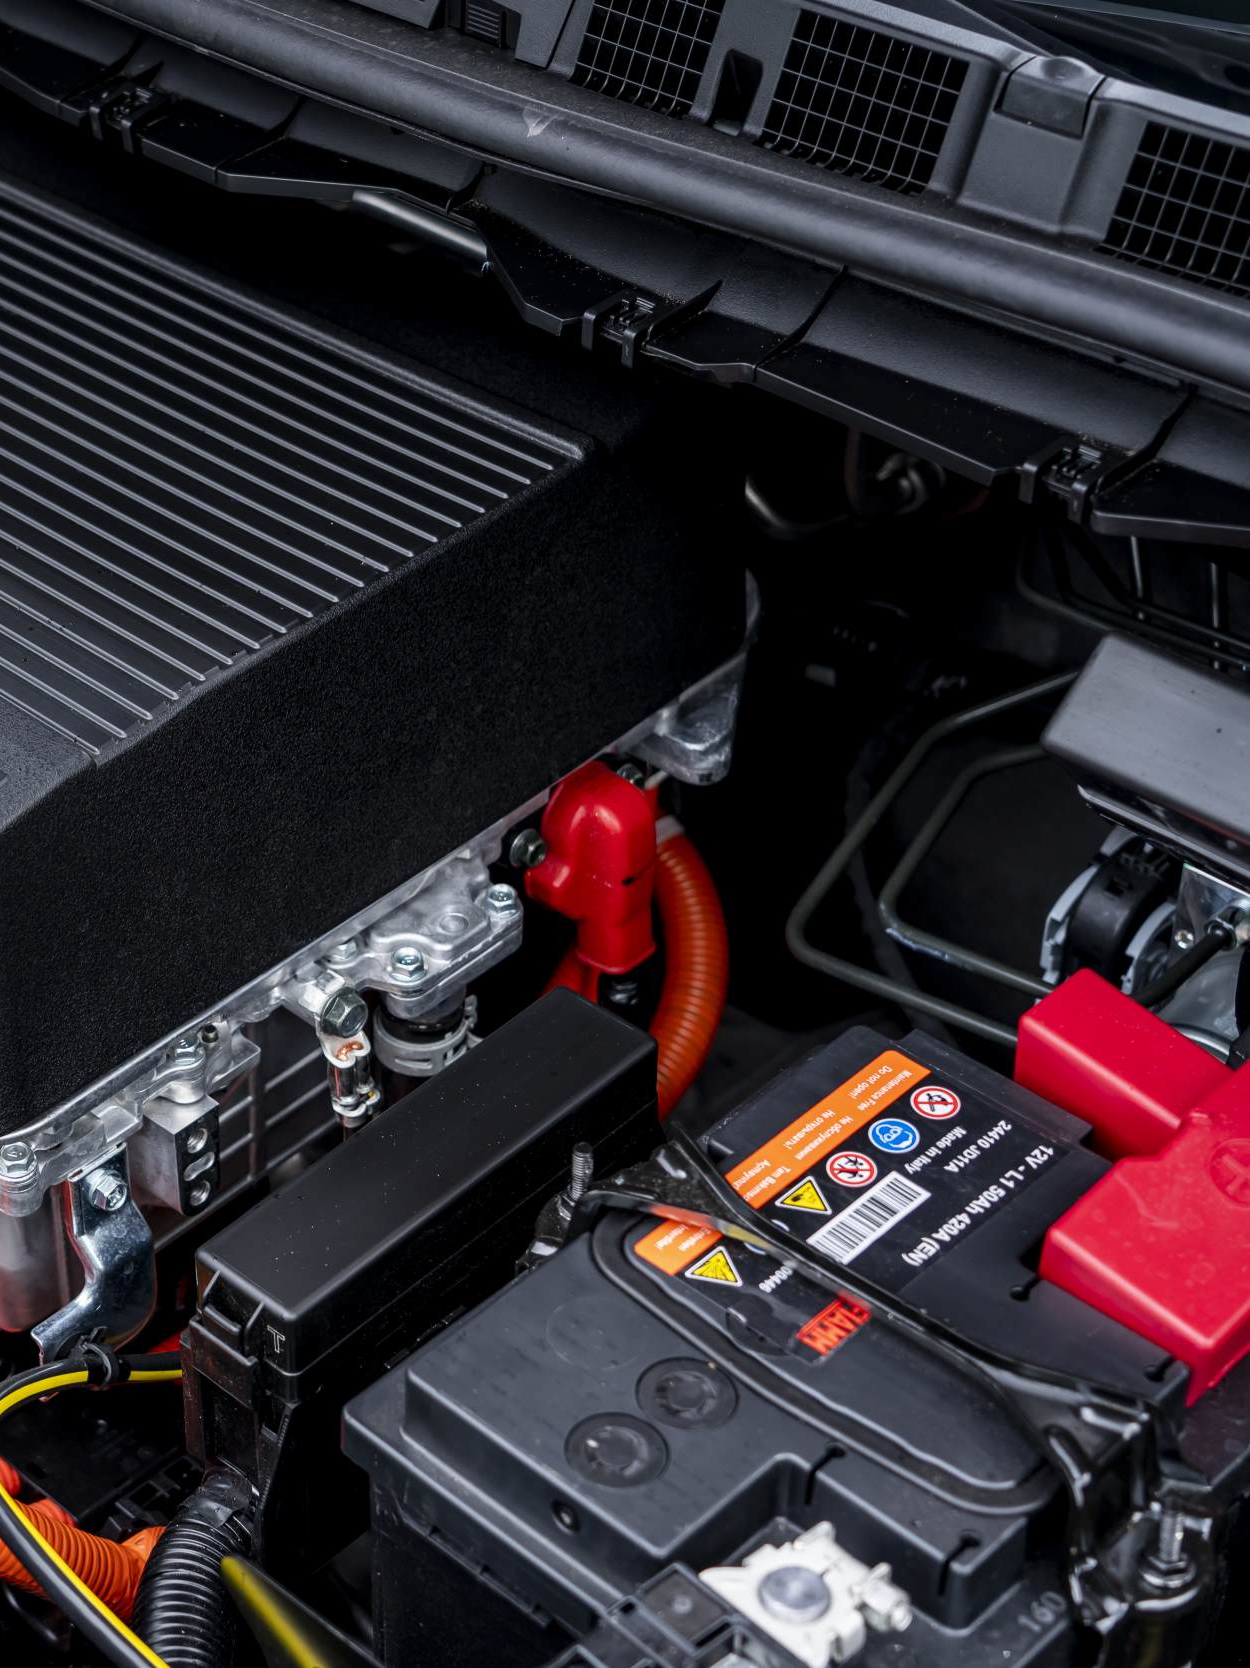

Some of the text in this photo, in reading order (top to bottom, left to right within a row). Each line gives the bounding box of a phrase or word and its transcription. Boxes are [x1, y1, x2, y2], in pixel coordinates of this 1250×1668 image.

[847, 1065, 893, 1100] Do not open!
[857, 1069, 912, 1112] Maintenance Free
[904, 1126, 966, 1175] Made in Italy
[943, 1119, 1012, 1173] 24410 JD11A
[1025, 1145, 1054, 1170] 12V
[999, 1170, 1025, 1188] L1
[964, 1184, 1007, 1214] 50Ah
[931, 1212, 972, 1242] 420A
[901, 1237, 941, 1267] (EN)
[266, 1324, 286, 1354] T
[799, 1296, 872, 1356] FIAMM
[1017, 1590, 1067, 1634] 160
